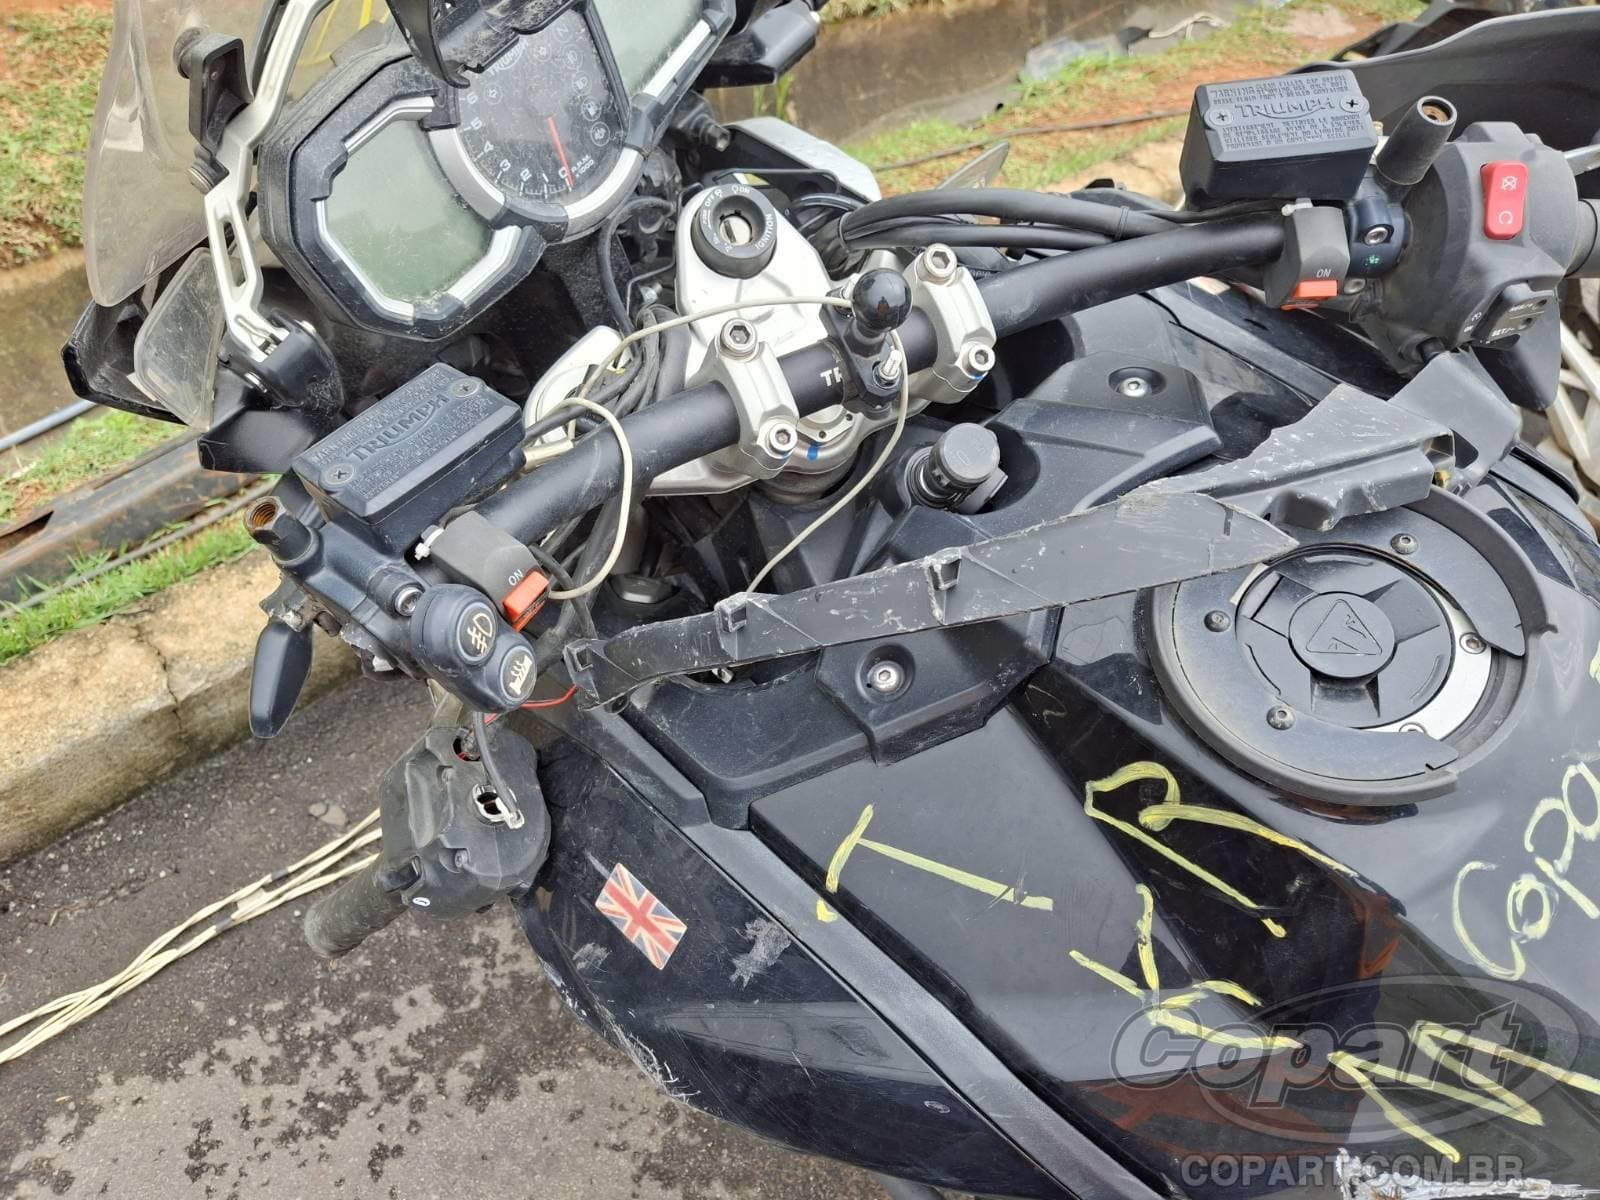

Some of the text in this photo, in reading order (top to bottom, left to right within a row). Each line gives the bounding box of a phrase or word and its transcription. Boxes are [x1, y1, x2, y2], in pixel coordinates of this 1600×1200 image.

[1235, 98, 1336, 119] TRIUMPH
[471, 117, 482, 130] 5
[483, 140, 494, 153] 4
[500, 159, 512, 172] 3
[520, 169, 532, 182] 2
[755, 213, 774, 250] IGNITION
[1316, 268, 1332, 278] ON
[347, 393, 451, 462] TRIUMPH
[508, 569, 525, 586] ON
